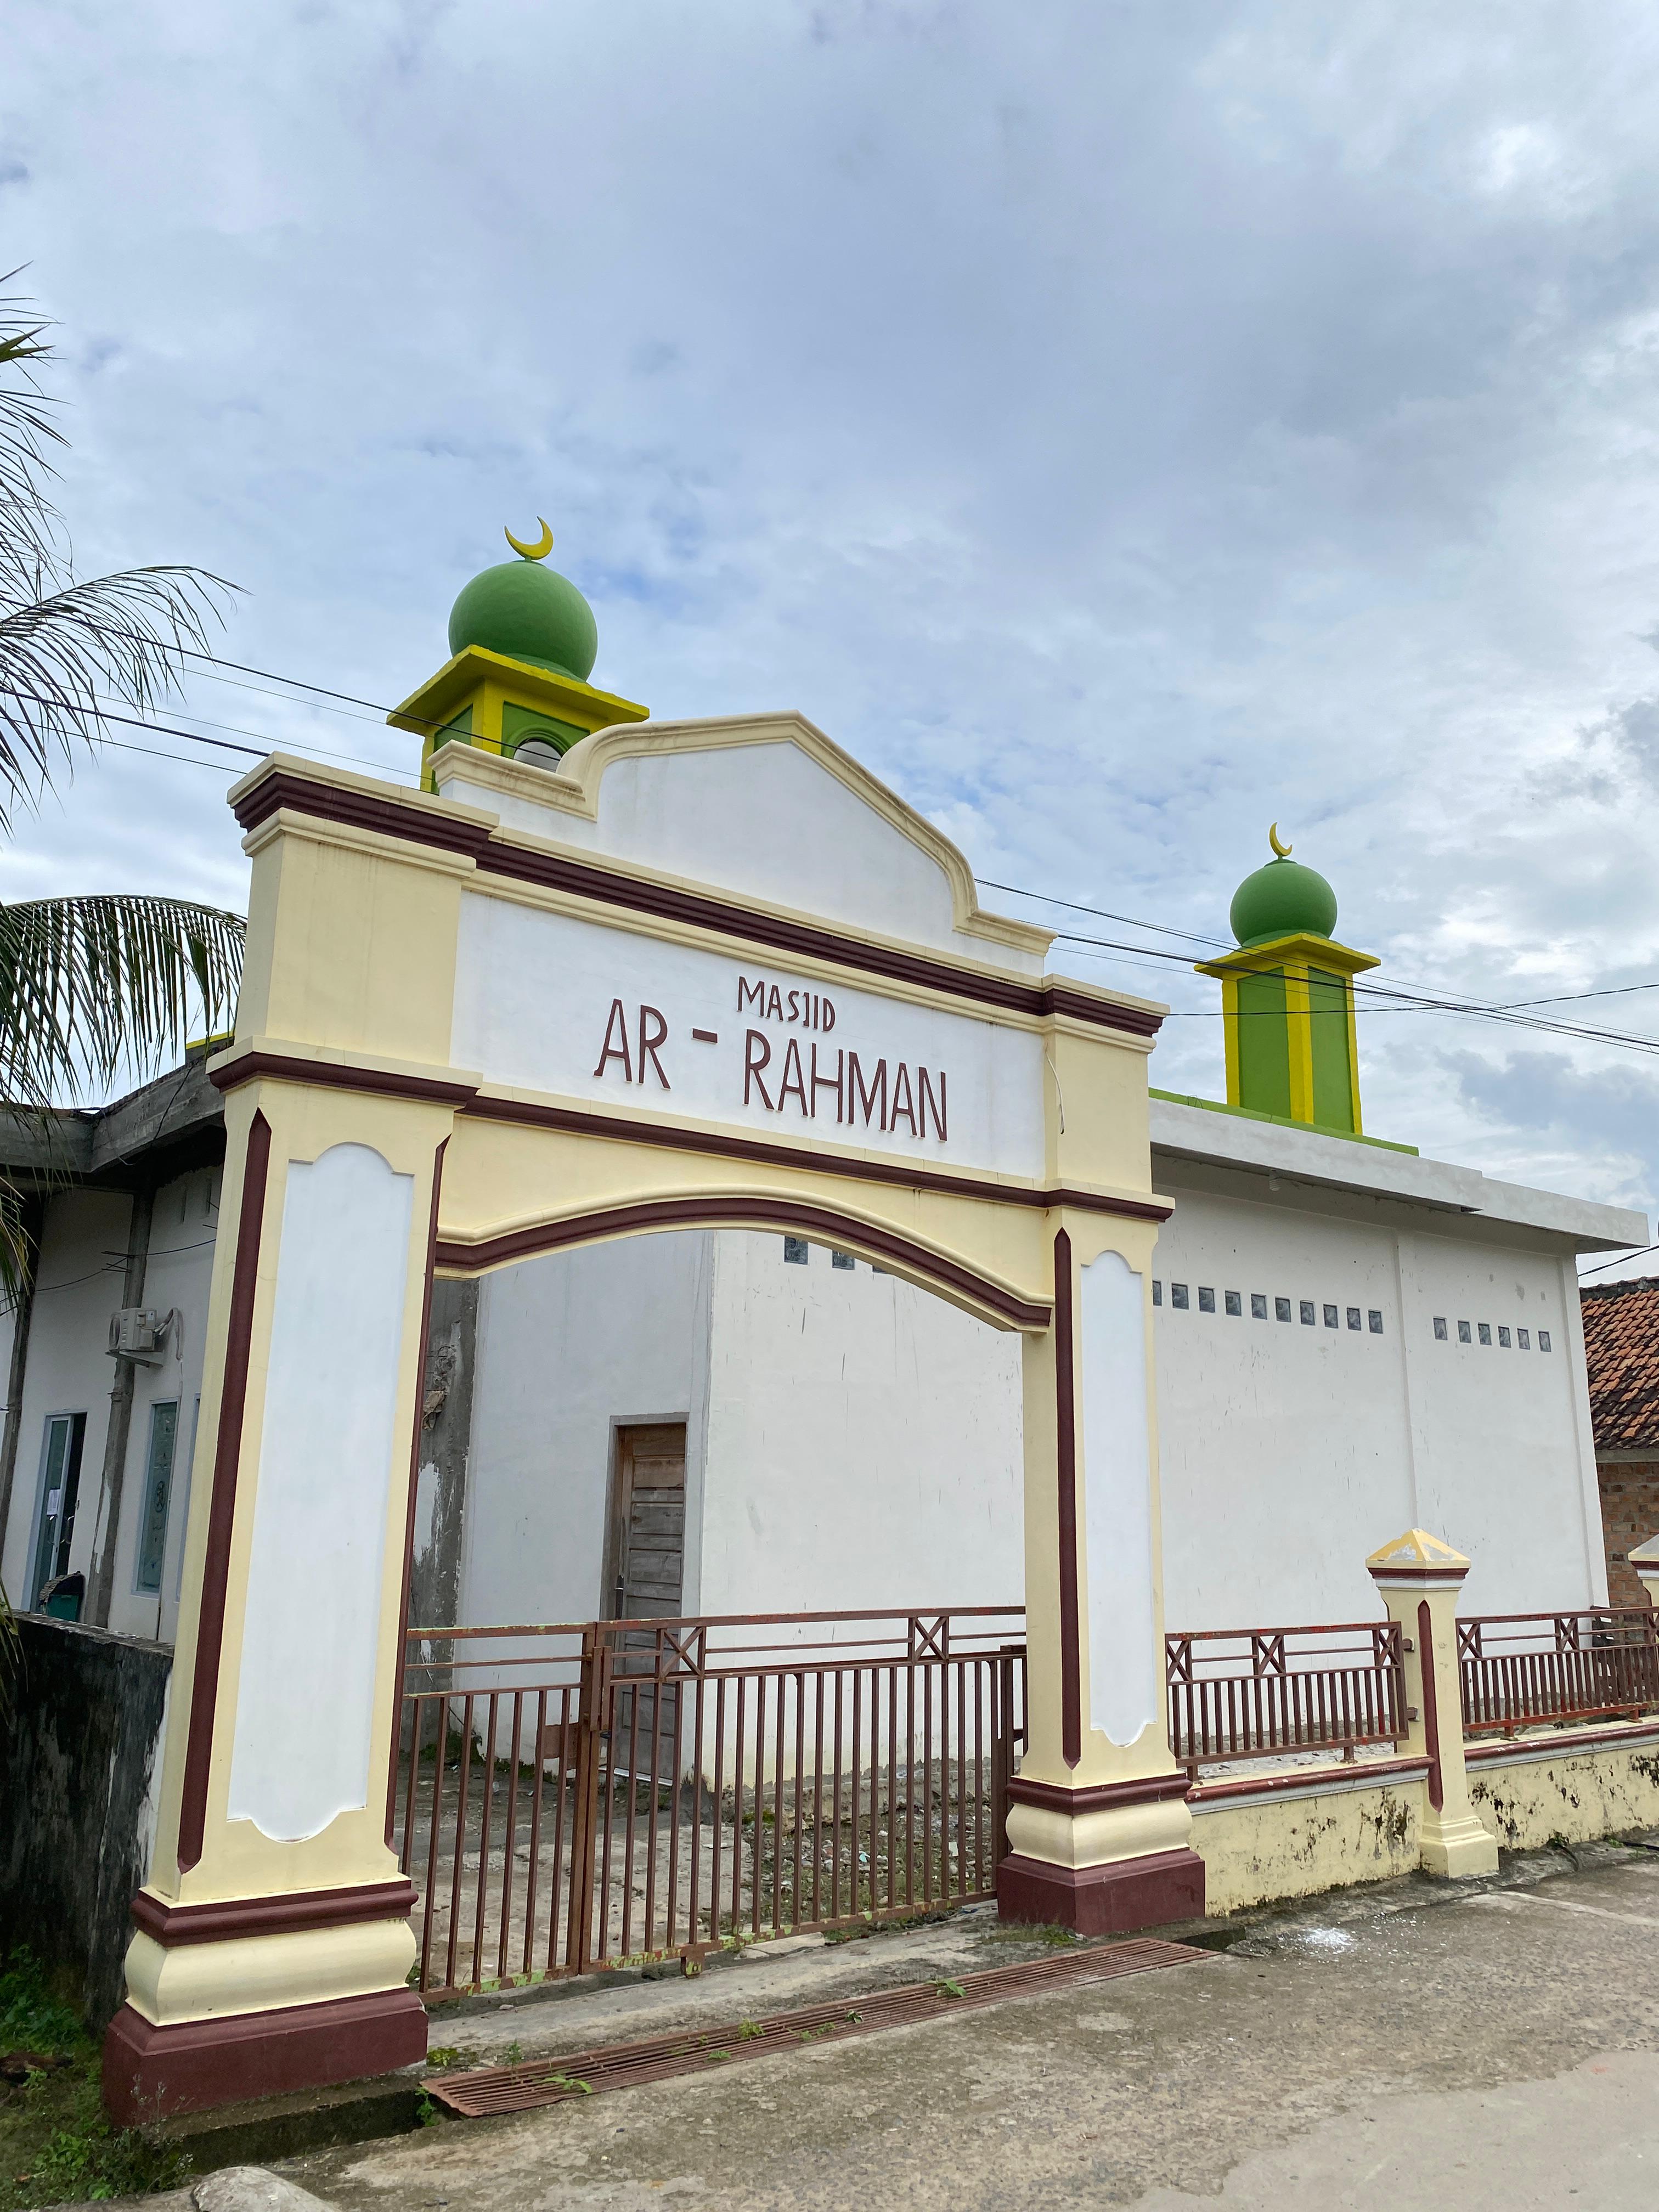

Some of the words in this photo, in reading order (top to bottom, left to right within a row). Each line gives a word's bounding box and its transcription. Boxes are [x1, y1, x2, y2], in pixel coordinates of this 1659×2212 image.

[737, 976, 836, 1032] MASJID
[593, 998, 671, 1090] AR
[743, 1029, 947, 1142] RAHMAN
